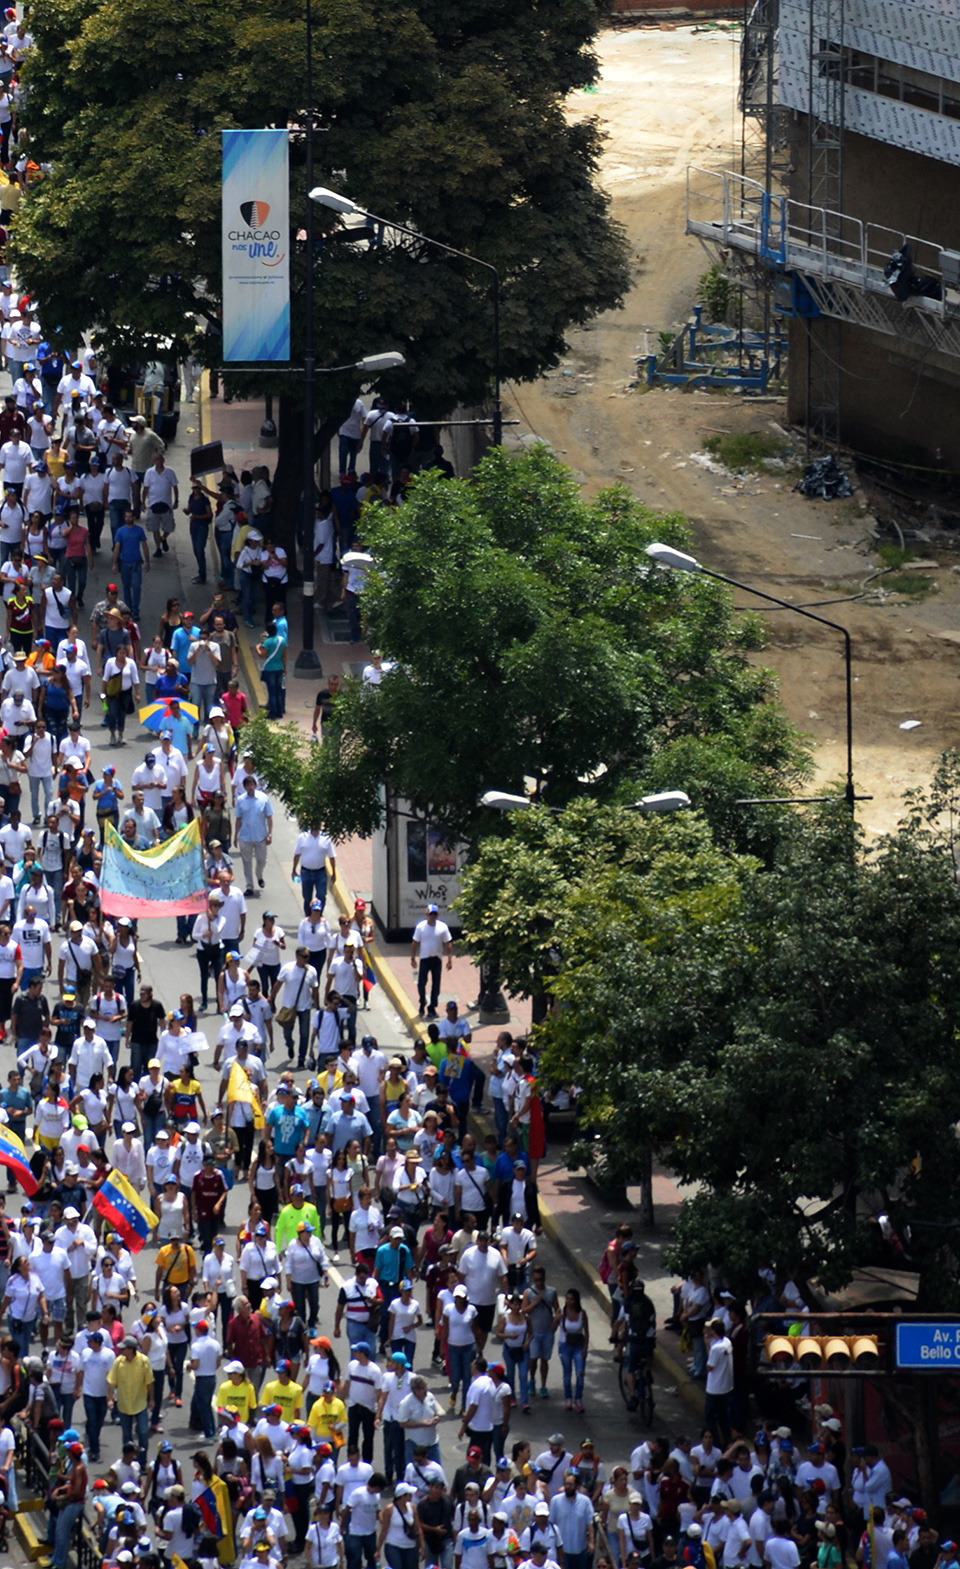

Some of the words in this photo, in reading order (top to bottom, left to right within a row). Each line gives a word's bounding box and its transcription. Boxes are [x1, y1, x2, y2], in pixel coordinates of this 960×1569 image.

[228, 230, 280, 241] CHACAO
[415, 884, 448, 901] Who?
[278, 1115, 300, 1127] JUST
[933, 1328, 953, 1343] Av.
[920, 1344, 952, 1359] Bello
